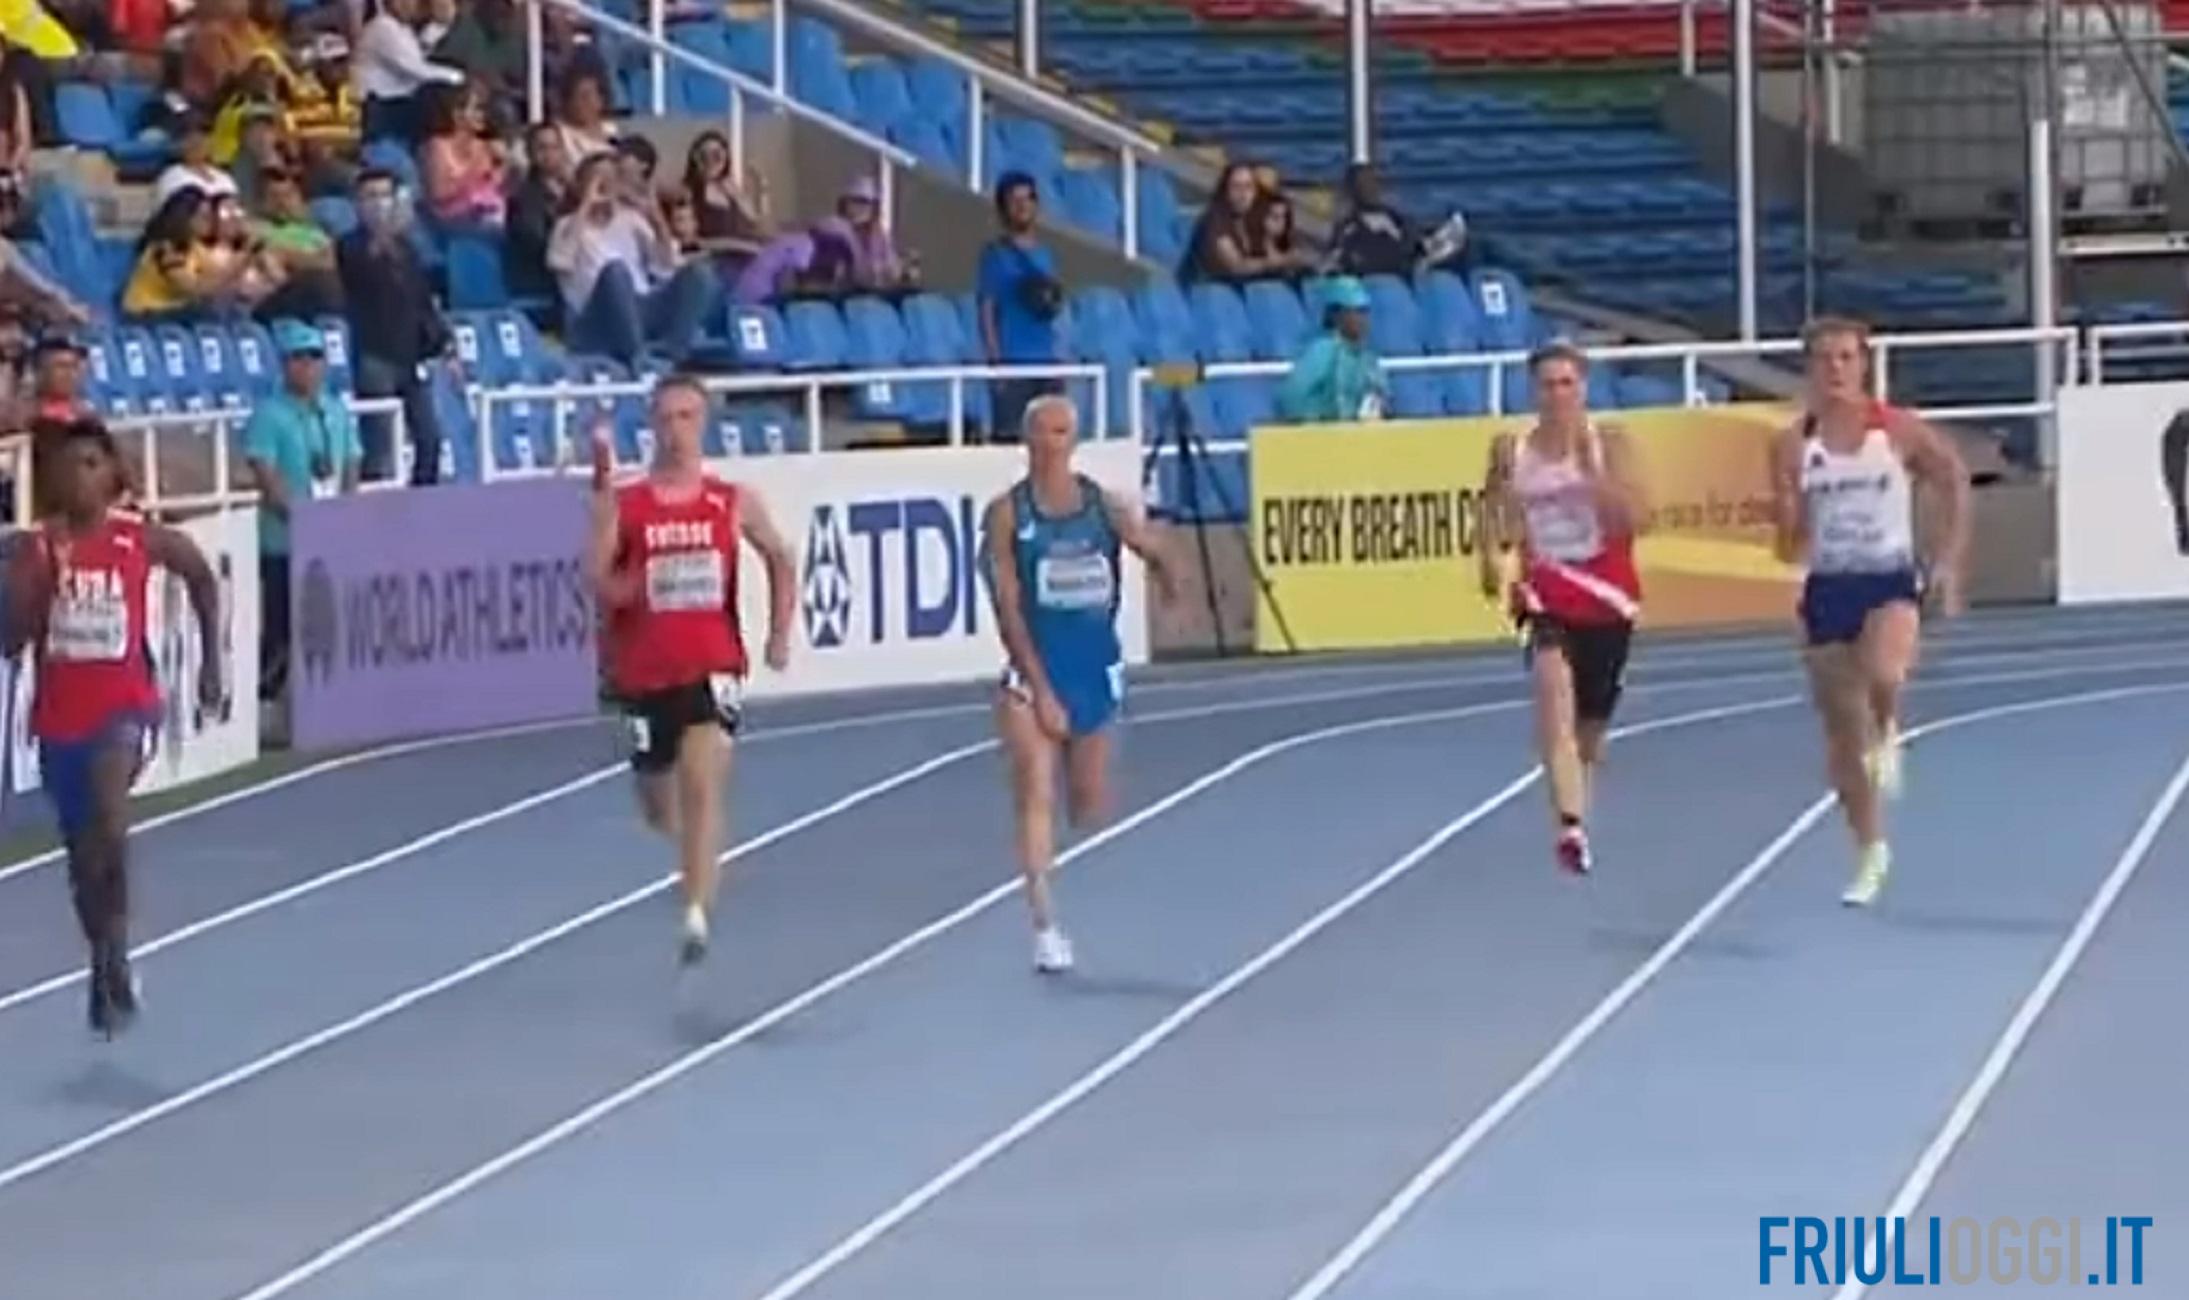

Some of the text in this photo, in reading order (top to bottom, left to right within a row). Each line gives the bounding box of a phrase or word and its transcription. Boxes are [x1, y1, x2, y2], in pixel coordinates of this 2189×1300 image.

[1263, 496, 1342, 563] EVERY
[1351, 490, 1450, 561] BREATH
[346, 571, 434, 668] WORLD
[437, 556, 588, 661] ATHLETICS
